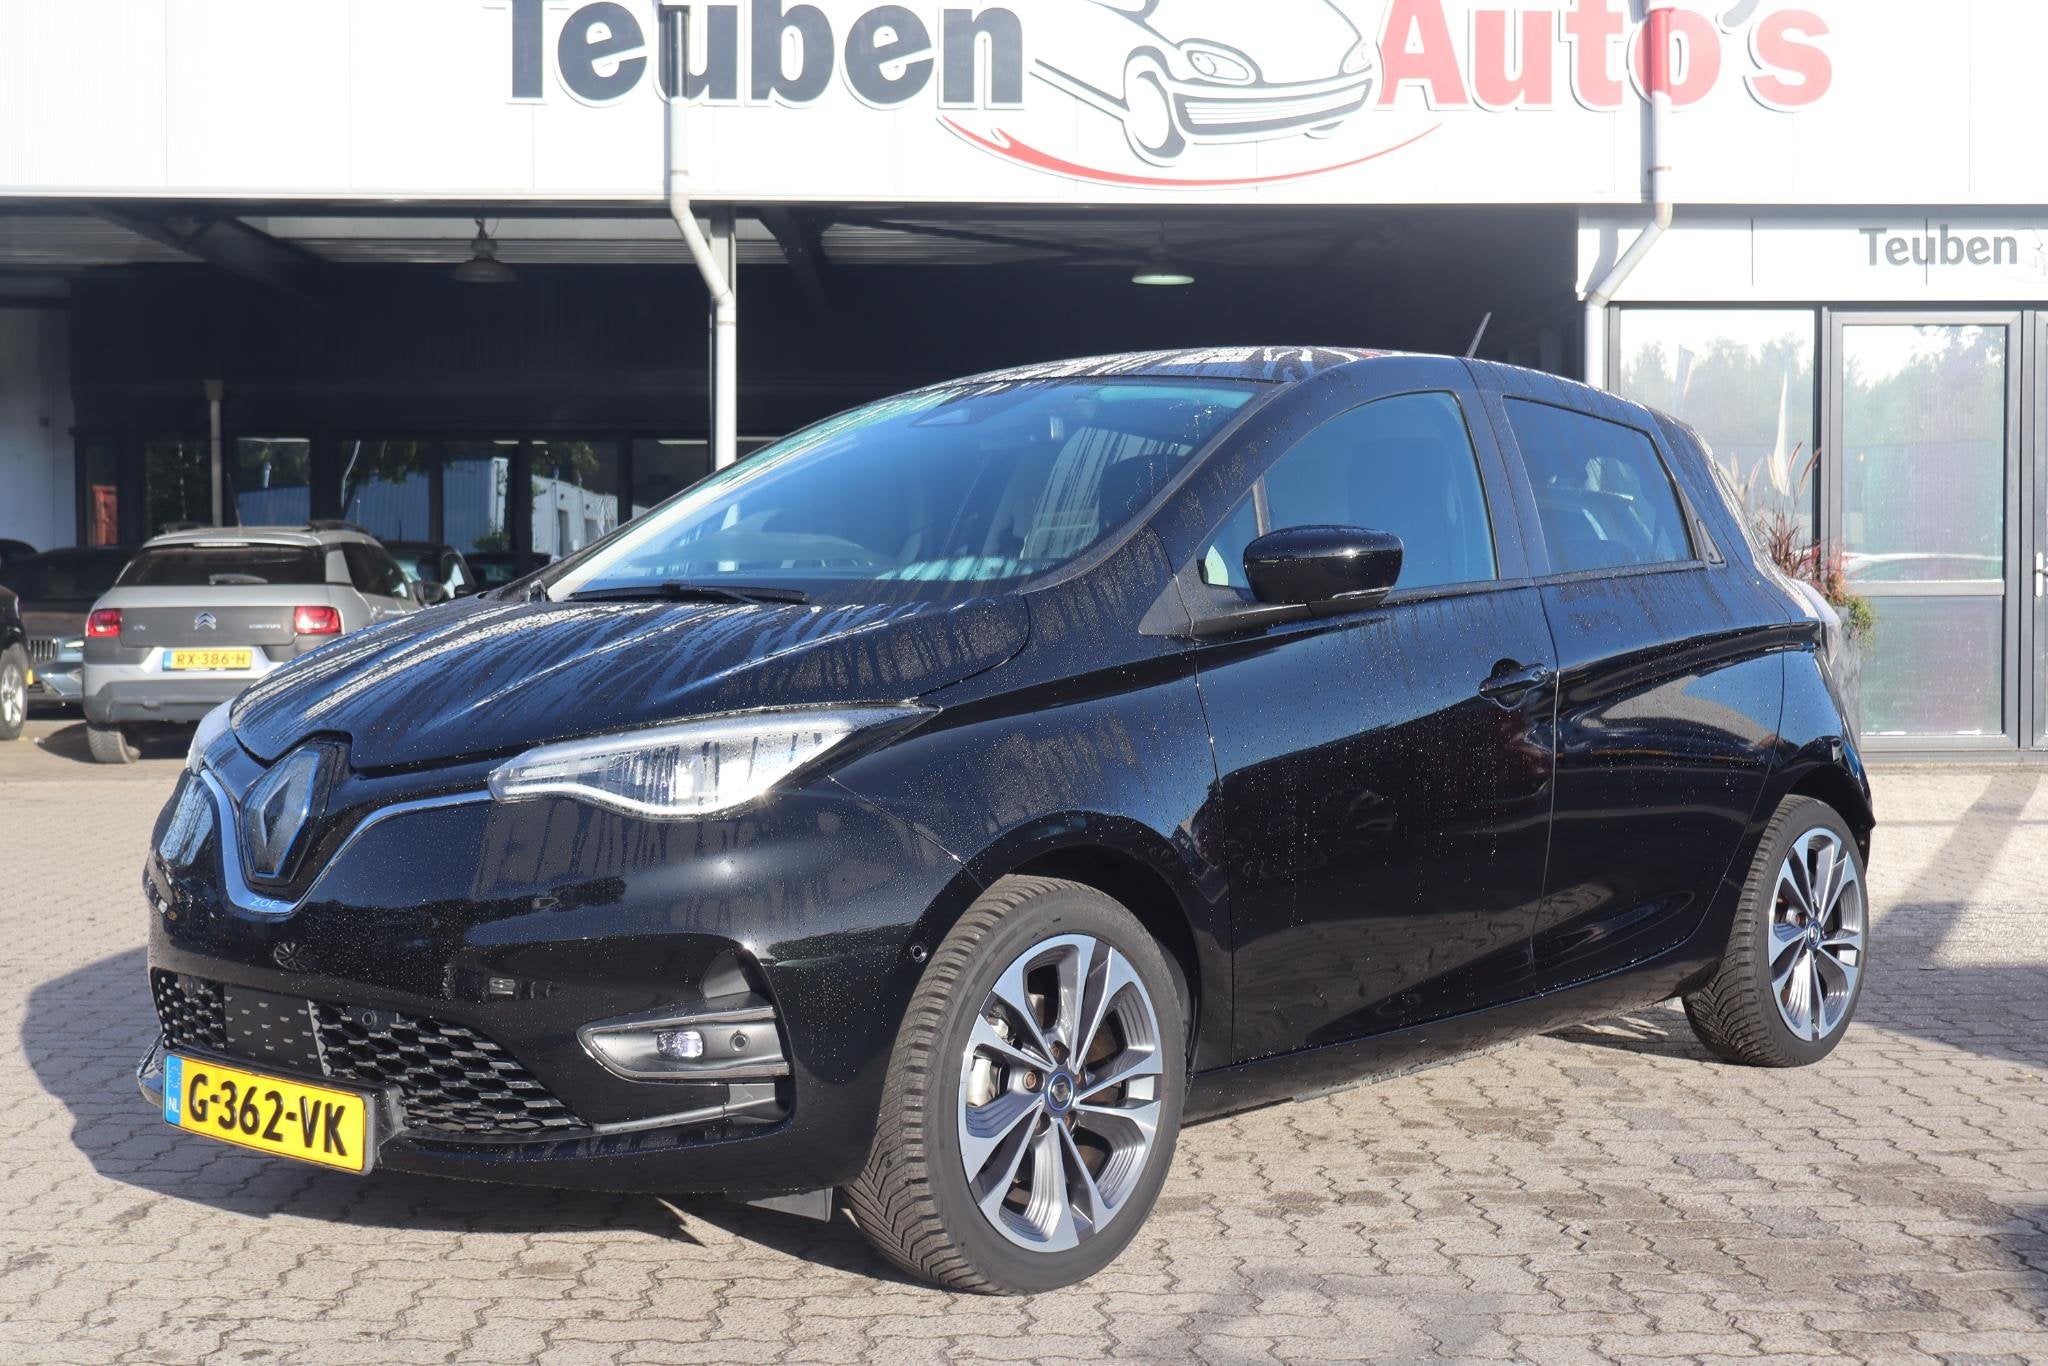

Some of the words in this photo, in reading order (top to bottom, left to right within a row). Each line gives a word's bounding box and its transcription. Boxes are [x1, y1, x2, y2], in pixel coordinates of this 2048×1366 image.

[1859, 224, 2018, 266] Teuben
[177, 654, 246, 666] RX-386-H
[250, 897, 280, 907] ZOE
[168, 1096, 180, 1113] NL
[188, 1073, 348, 1157] G-362-VK
